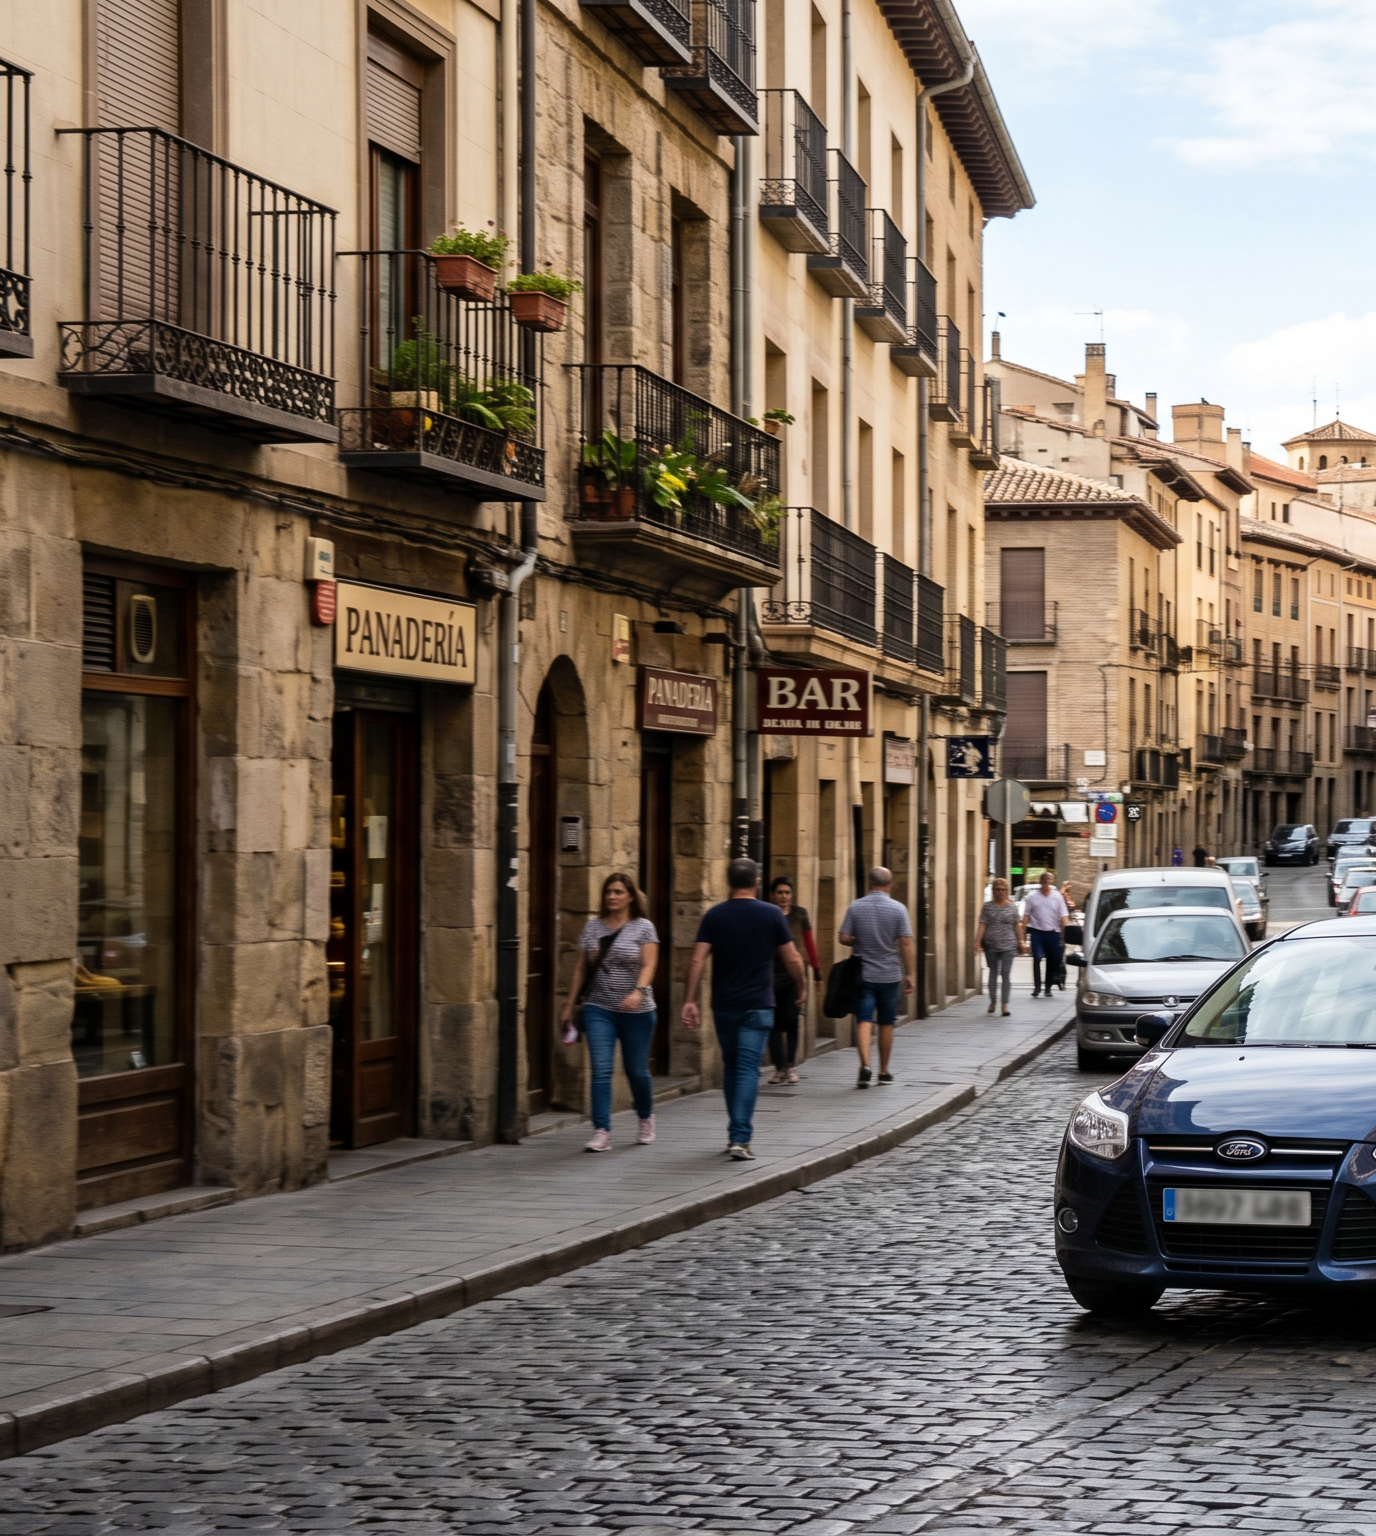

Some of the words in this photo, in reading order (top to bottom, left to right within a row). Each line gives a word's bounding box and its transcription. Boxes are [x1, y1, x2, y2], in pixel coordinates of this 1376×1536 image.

[345, 606, 468, 668] PANADERÍA
[647, 677, 714, 712] PANADERÍA
[766, 677, 862, 711] BAR
[1226, 1143, 1252, 1156] Ford
